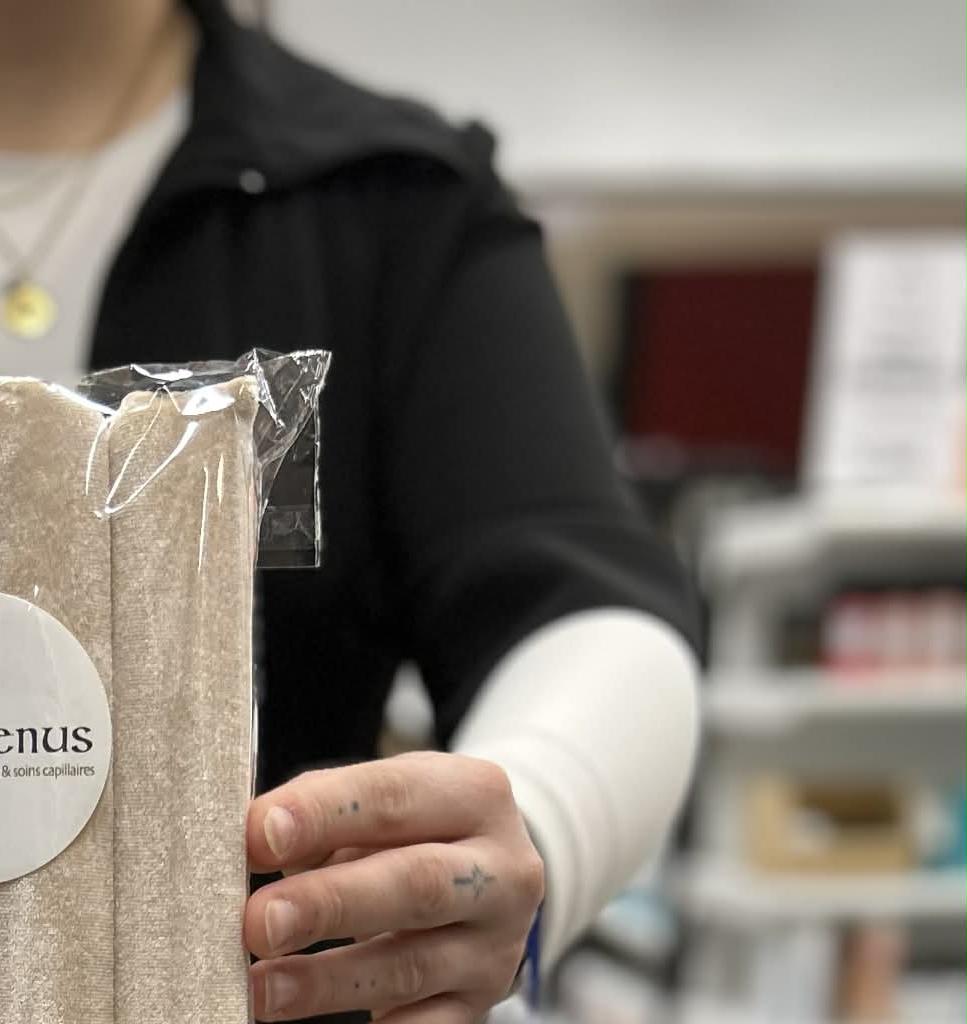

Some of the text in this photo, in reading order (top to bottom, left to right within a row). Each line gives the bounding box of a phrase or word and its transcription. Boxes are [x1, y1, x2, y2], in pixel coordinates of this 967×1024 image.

[1, 765, 11, 777] &
[13, 764, 41, 777] soins
[42, 763, 95, 779] capillaires
